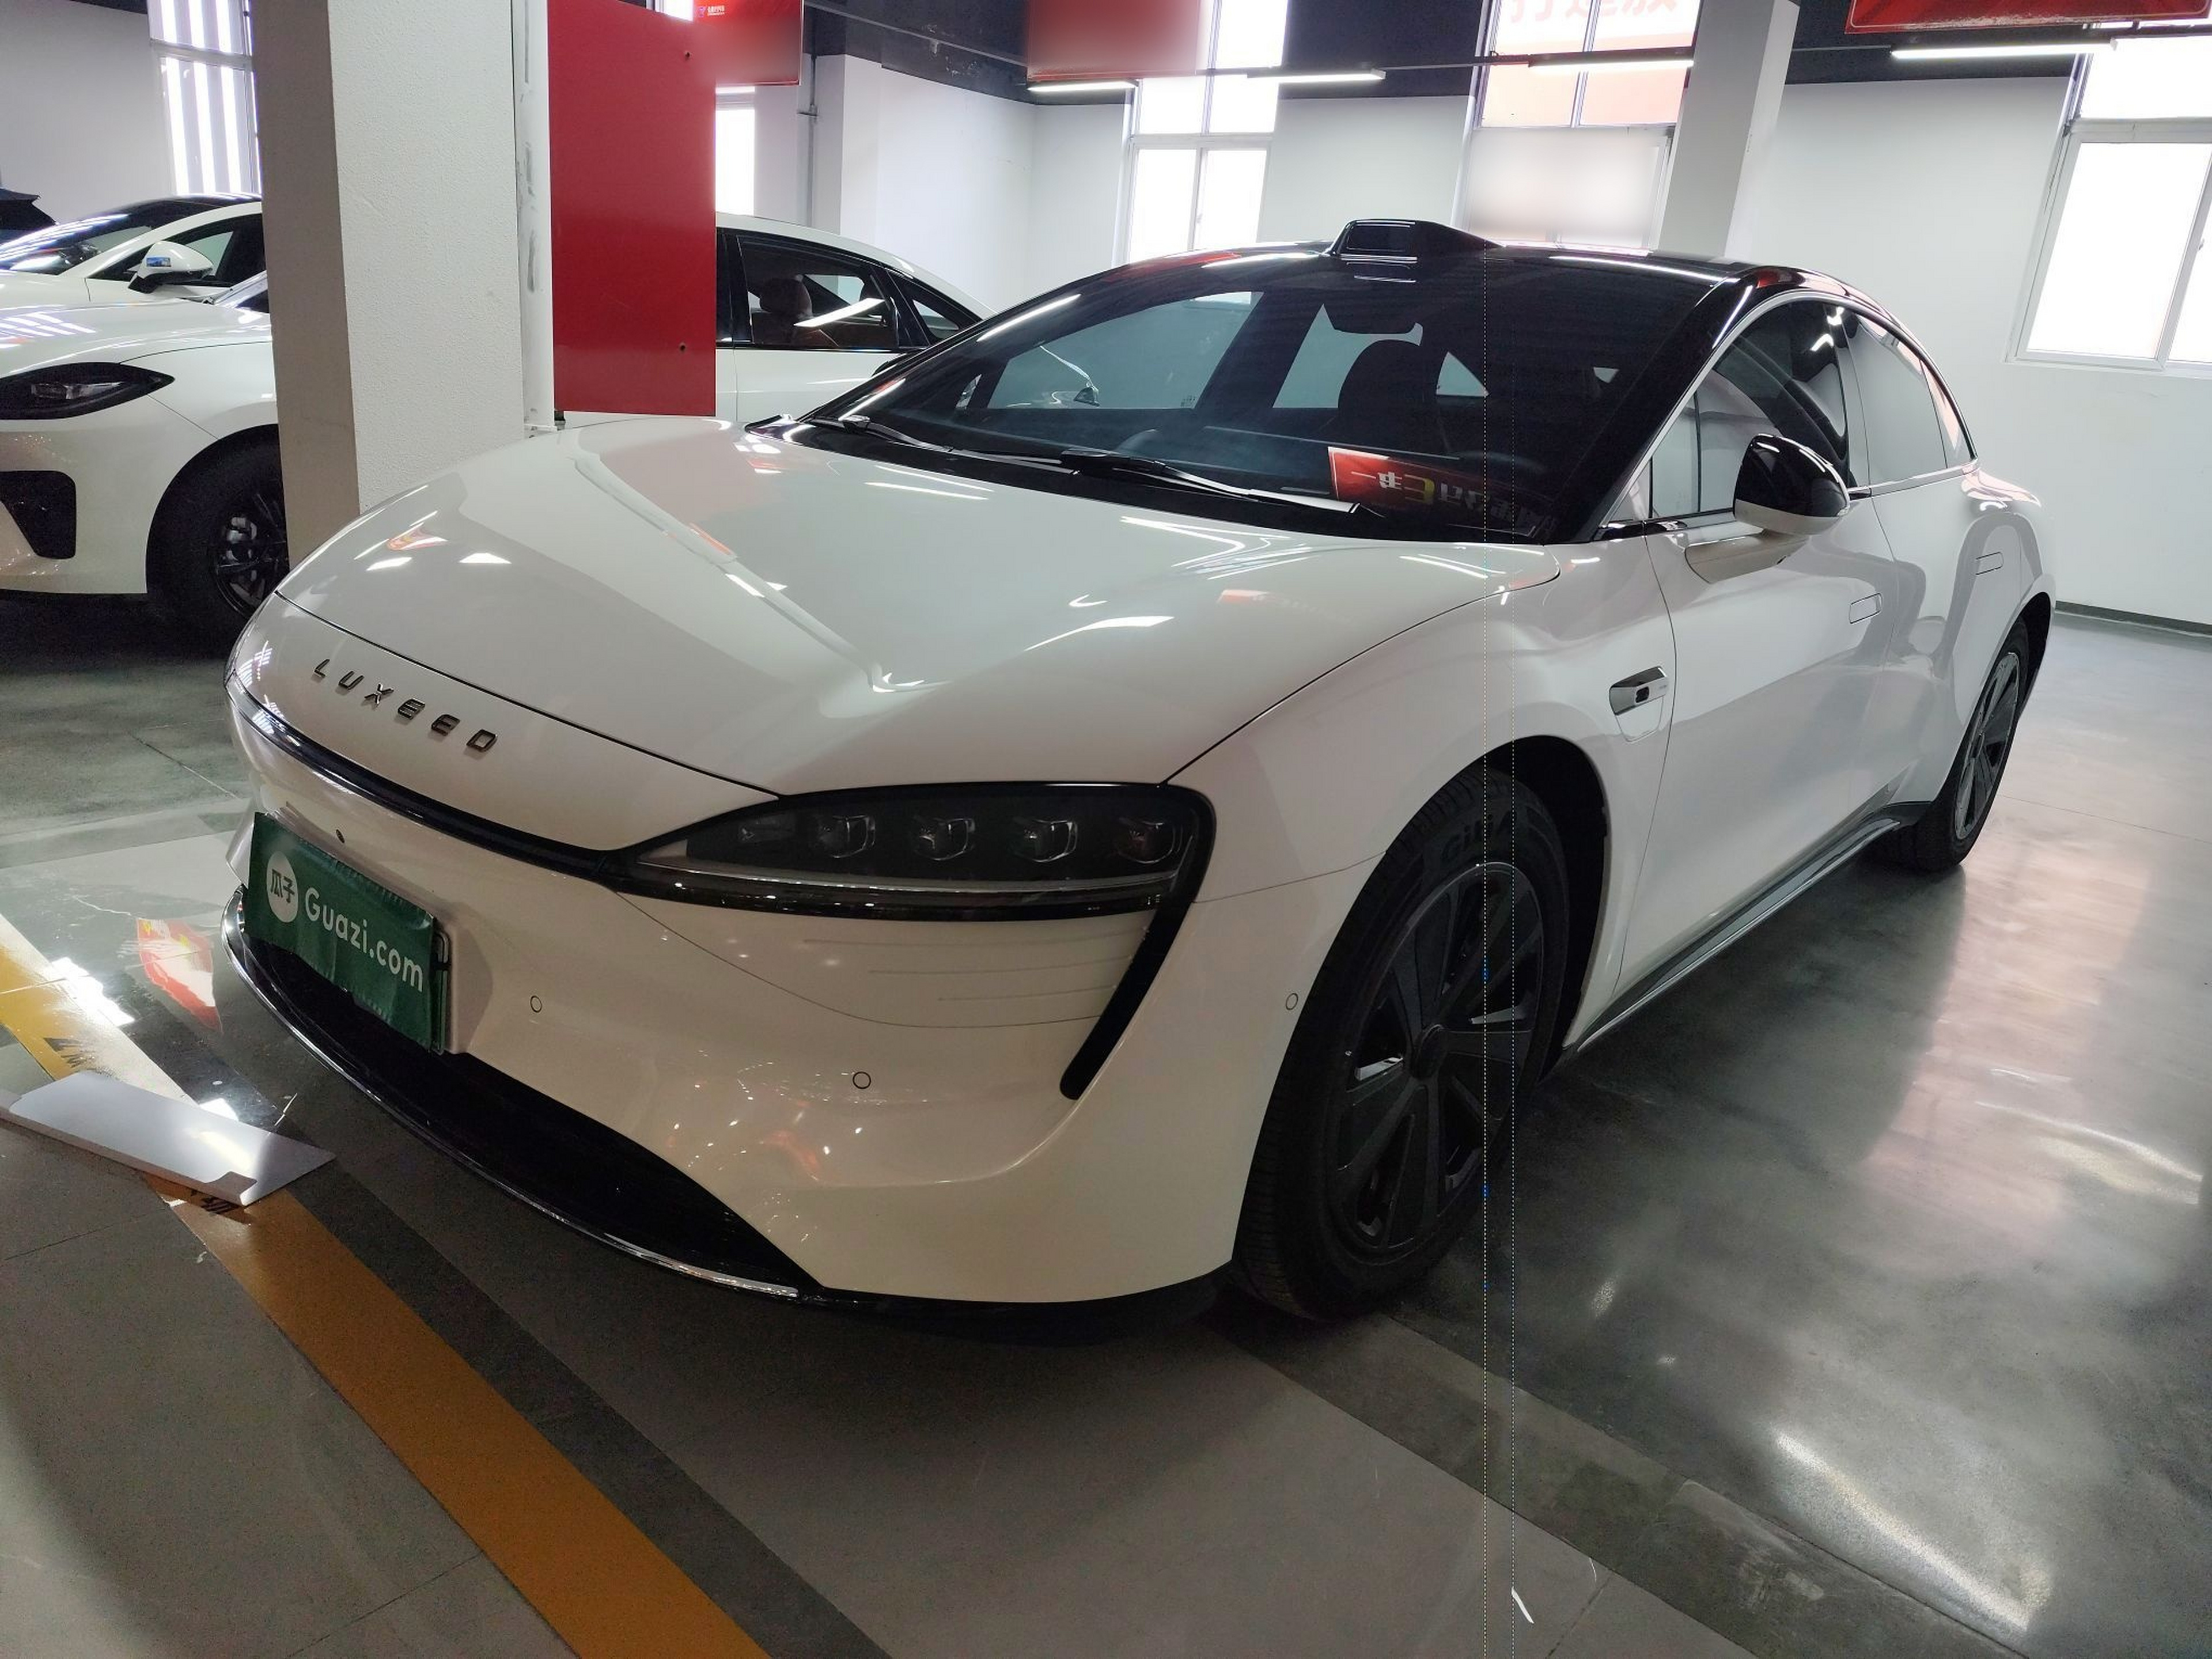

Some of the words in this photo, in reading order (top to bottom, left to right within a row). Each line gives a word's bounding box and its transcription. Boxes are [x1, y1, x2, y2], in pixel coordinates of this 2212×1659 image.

[313, 658, 498, 752] LUXEED
[270, 869, 296, 903] 瓜子
[305, 887, 423, 993] Guazi.com
